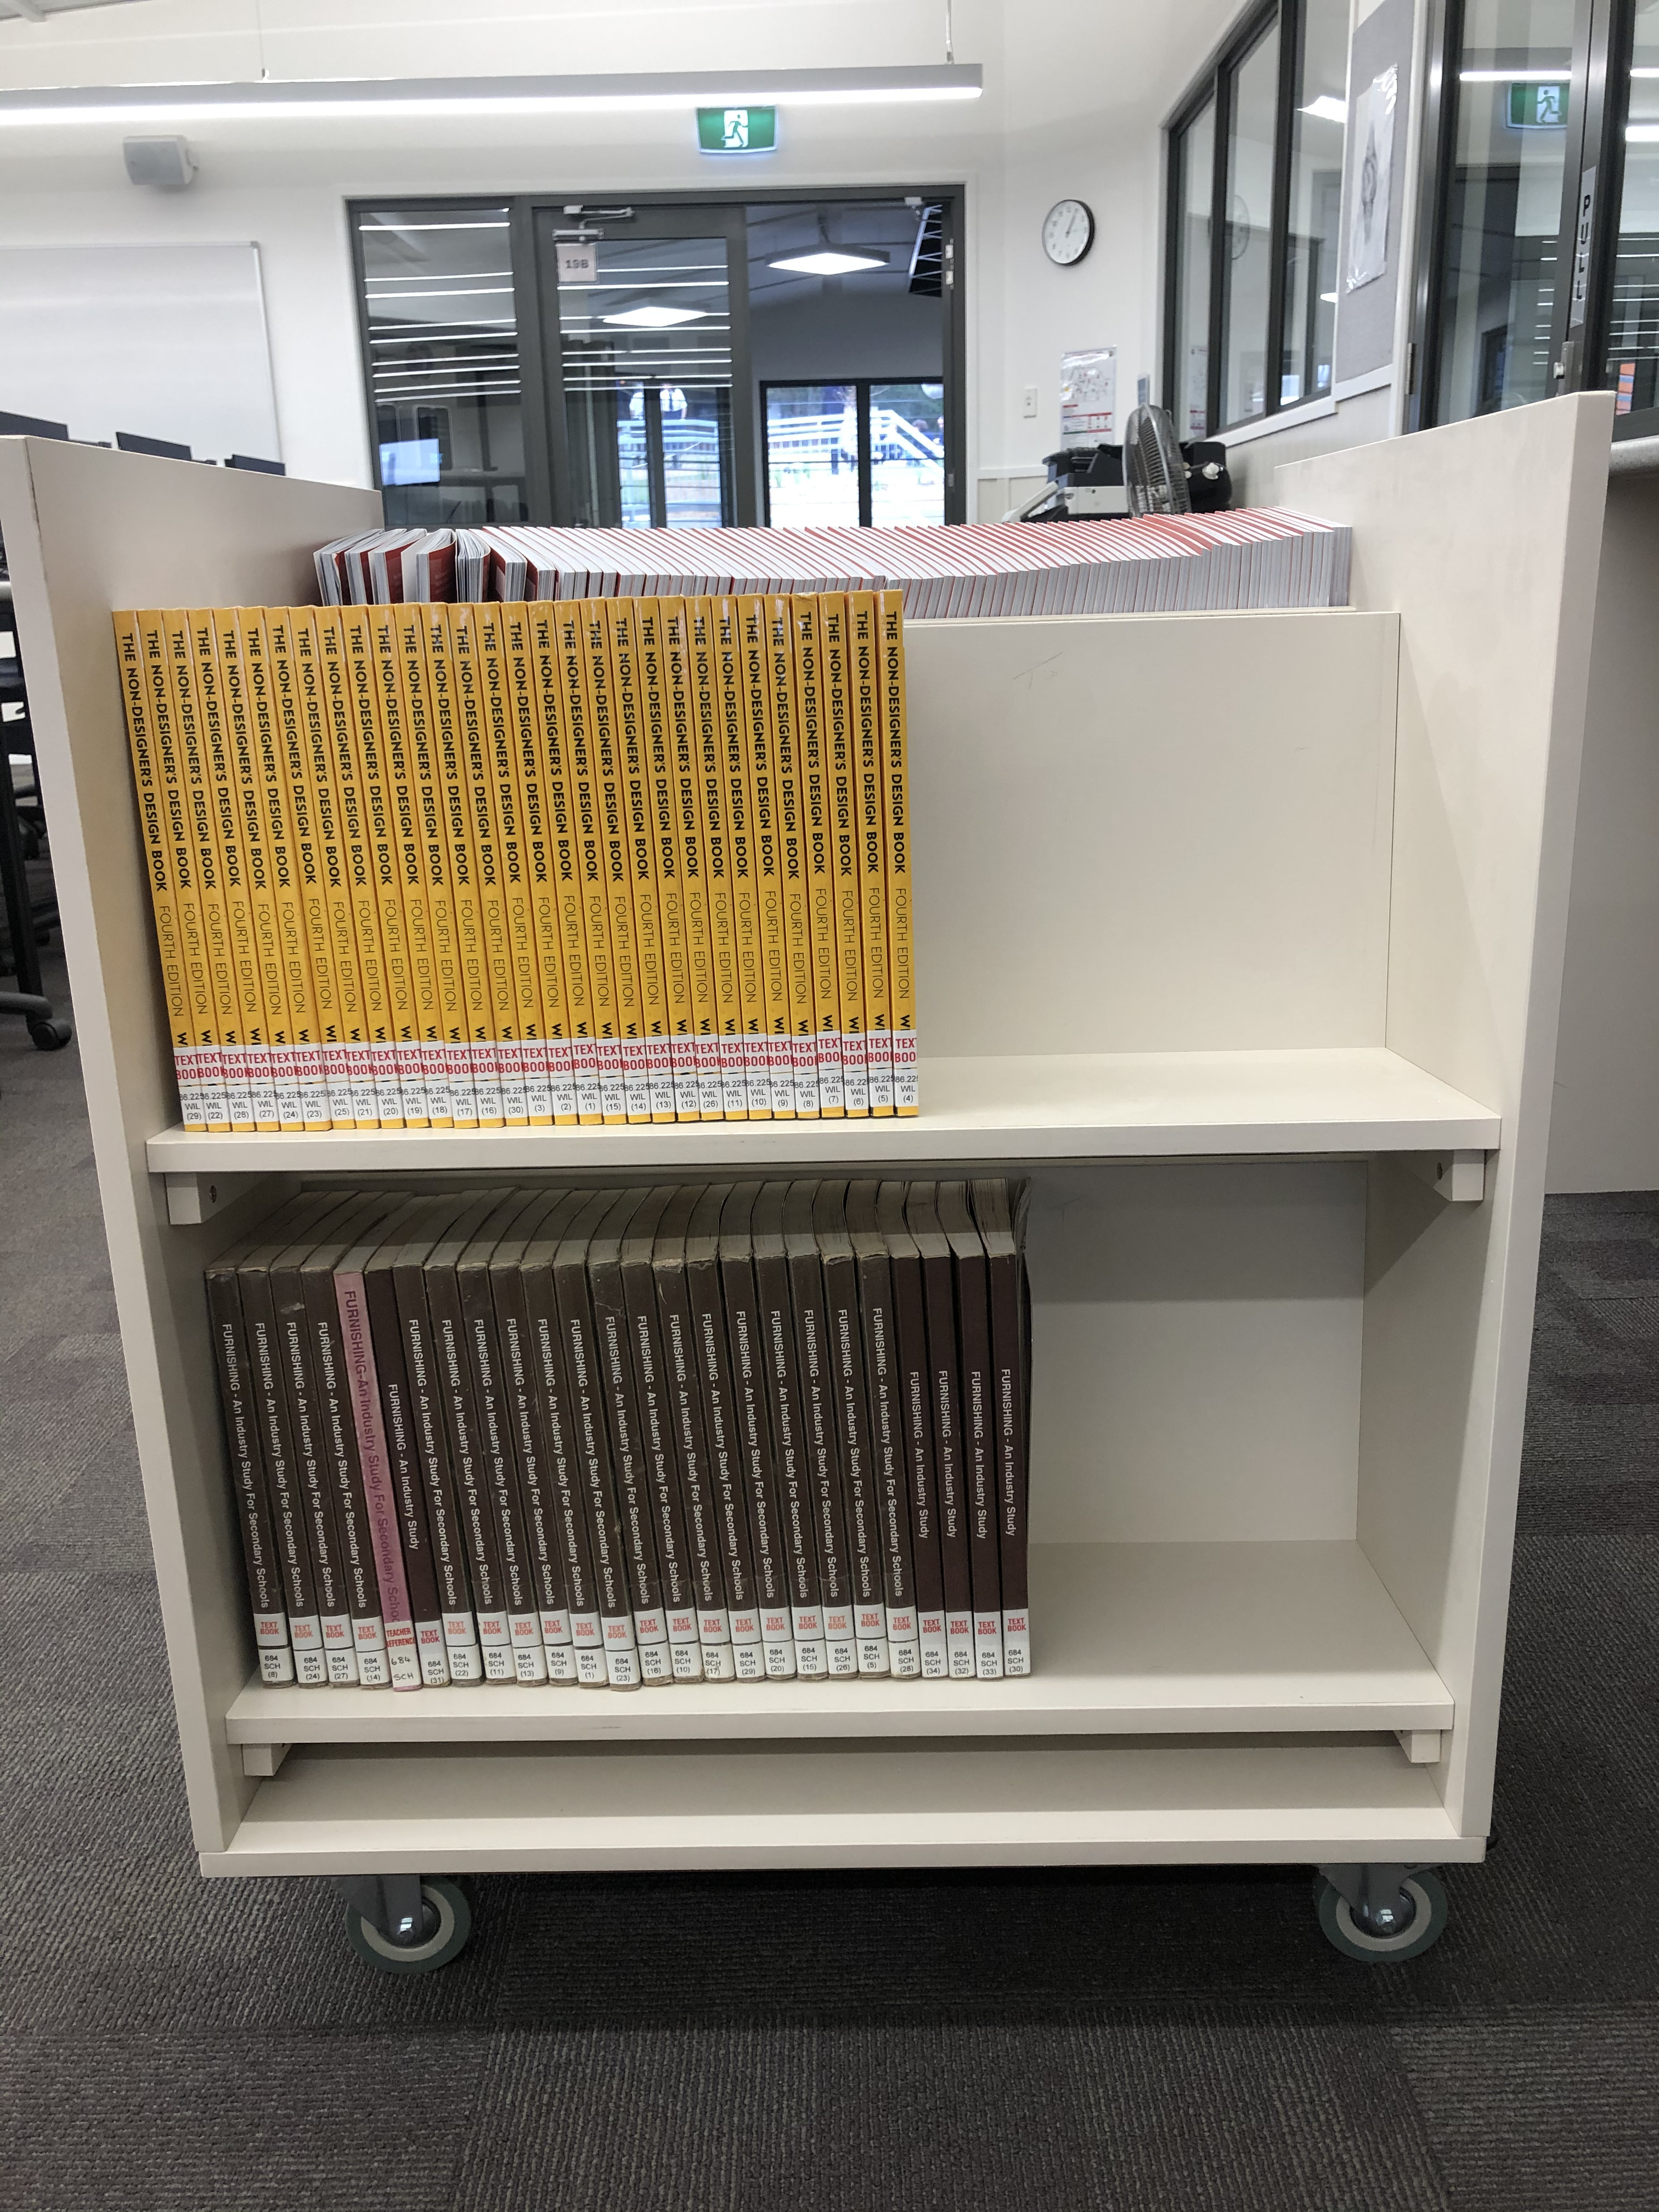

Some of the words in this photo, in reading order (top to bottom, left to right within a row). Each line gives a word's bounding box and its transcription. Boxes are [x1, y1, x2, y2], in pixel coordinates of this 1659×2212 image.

[1576, 195, 1590, 300] PULL
[272, 624, 286, 653] THE
[456, 625, 470, 654] THE
[642, 616, 654, 645] THE
[827, 613, 839, 642] THE
[885, 611, 898, 640] THE
[122, 633, 136, 662] THE
[143, 792, 161, 844] DESIGN
[292, 785, 310, 837] DESIGN
[474, 786, 490, 838] DESIGN
[656, 778, 671, 831] DESIGN
[836, 776, 849, 828] DESIGN
[891, 774, 904, 826] DESIGN
[151, 850, 167, 891] BOOK
[301, 842, 317, 884] BOOK
[481, 844, 496, 886] BOOK
[661, 837, 675, 878] BOOK
[839, 834, 851, 876] BOOK
[893, 832, 905, 874] BOOK
[159, 906, 176, 958] FOURTH
[308, 898, 325, 951] FOURTH
[487, 900, 503, 952] FOURTH
[665, 893, 680, 945] FOURTH
[842, 890, 855, 943] FOURTH
[895, 888, 907, 940] FOURTH
[166, 964, 184, 1016] EDITION
[315, 957, 332, 1009] EDITION
[493, 958, 509, 1010] EDITION
[670, 952, 685, 1003] EDITION
[844, 949, 857, 1001] EDITION
[897, 947, 909, 998] EDITION
[187, 1112, 201, 1120] (29)
[307, 1110, 322, 1119] (23)
[585, 1103, 596, 1111] (1)
[703, 1101, 718, 1109] (26)
[728, 1099, 742, 1108] (11)
[854, 1098, 864, 1107] (6)
[904, 1095, 913, 1103] (4)
[255, 1323, 273, 1389] FURNISHING
[506, 1318, 524, 1385] FURNISHING
[702, 1313, 718, 1380] FURNISHING
[838, 1309, 852, 1376] FURNISHING
[266, 1398, 275, 1412] An
[517, 1395, 527, 1408] An
[710, 1390, 720, 1403] An
[844, 1386, 854, 1400] An
[1001, 1369, 1013, 1435] FURNISHING
[268, 1415, 281, 1457] Industry
[360, 1400, 375, 1451] Industry
[520, 1411, 532, 1453] Industry
[713, 1406, 725, 1448] Industry
[846, 1402, 857, 1444] Industry
[368, 1454, 380, 1489] Study
[526, 1456, 538, 1485] Study
[718, 1451, 730, 1480] Study
[850, 1447, 861, 1477] Study
[1004, 1444, 1013, 1459] An
[275, 1460, 287, 1489] Study
[722, 1483, 731, 1500] For
[853, 1480, 862, 1497] For
[1004, 1462, 1014, 1503] Industry
[280, 1492, 289, 1509] For
[374, 1494, 384, 1514] For
[531, 1488, 540, 1505] For
[283, 1511, 297, 1564] Secondary
[533, 1508, 548, 1561] Secondary
[724, 1503, 737, 1556] Secondary
[855, 1500, 867, 1553] Secondary
[1005, 1506, 1016, 1536] Study
[377, 1517, 393, 1582] Secondary
[291, 1567, 304, 1606] Schools
[541, 1564, 555, 1604] Schools
[731, 1559, 744, 1600] Schools
[860, 1556, 871, 1597] Schools
[386, 1628, 411, 1637] TEACHER
[391, 1657, 410, 1666] 684
